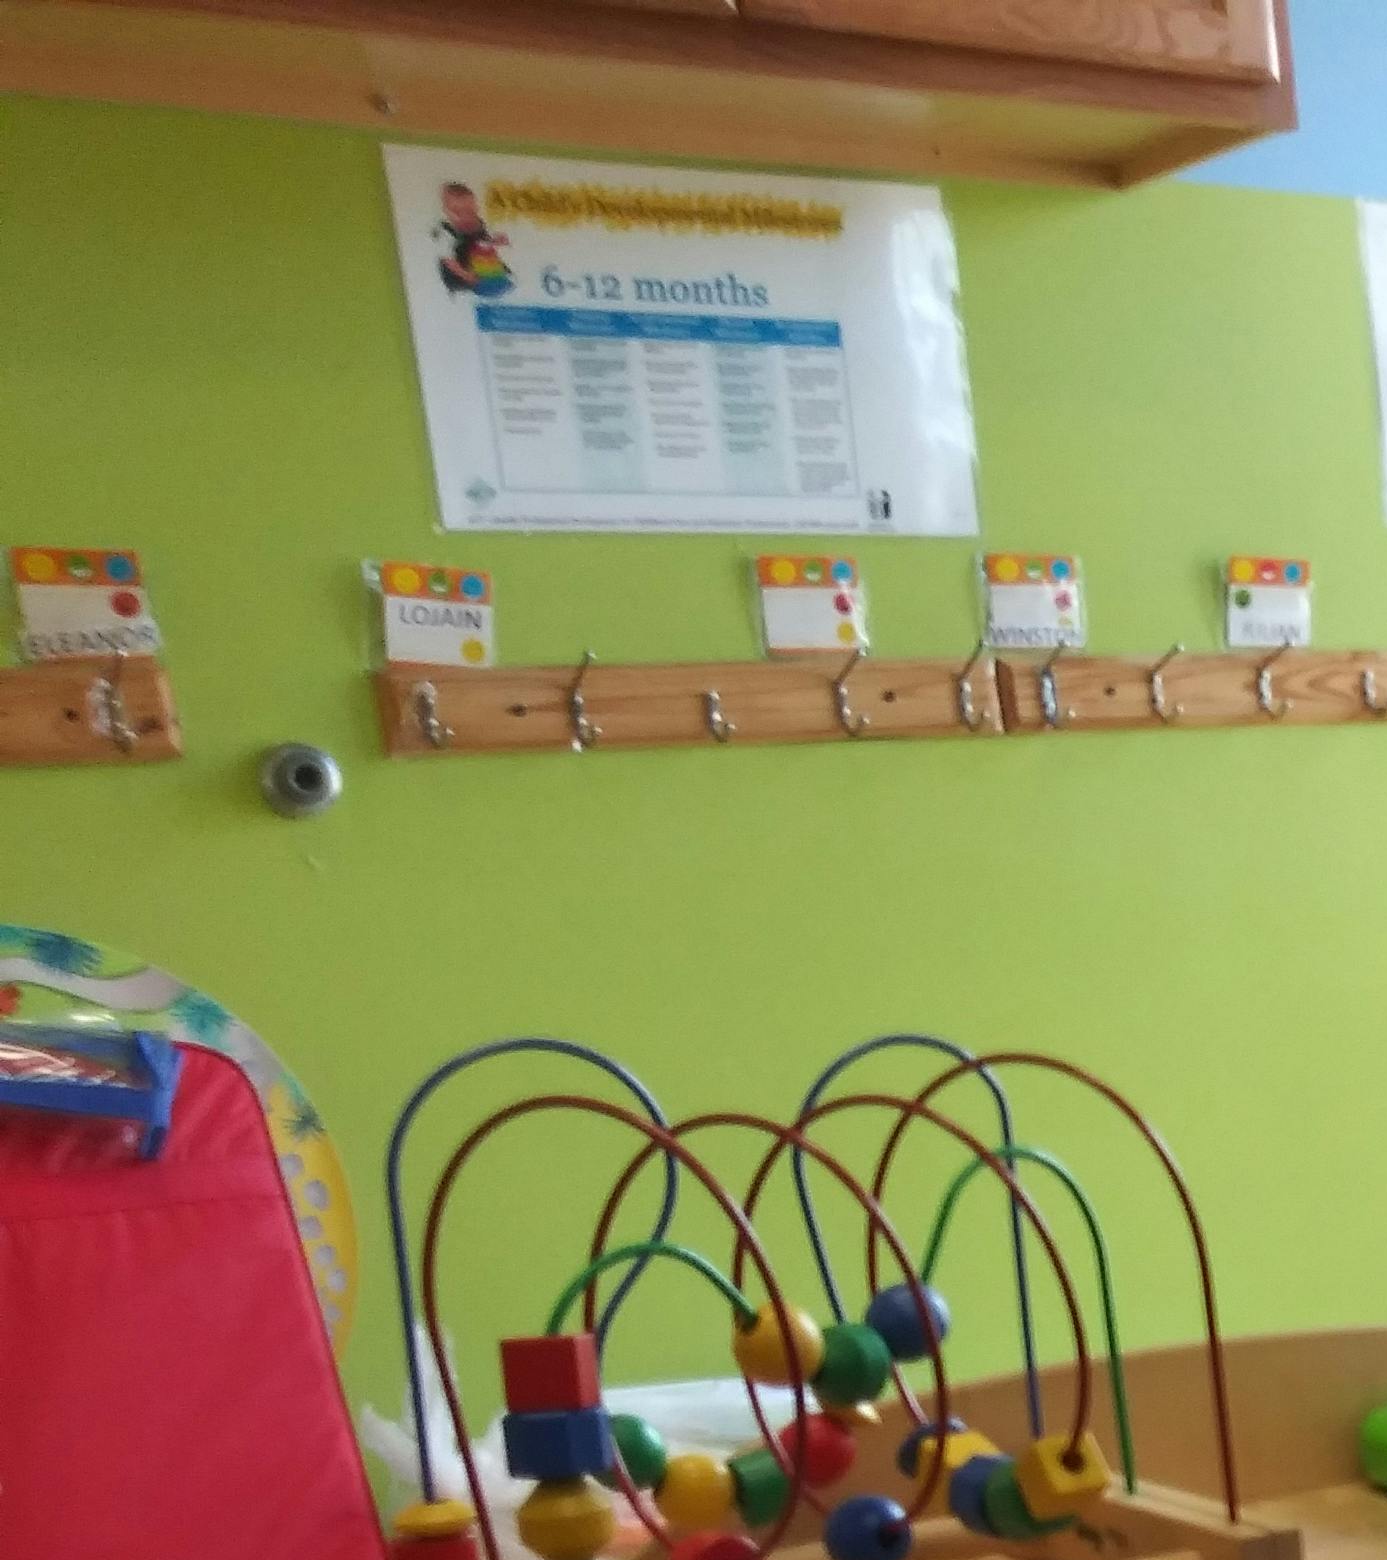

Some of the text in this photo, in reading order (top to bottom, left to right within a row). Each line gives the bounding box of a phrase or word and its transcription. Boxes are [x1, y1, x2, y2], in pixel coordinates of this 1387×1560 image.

[541, 263, 770, 307] 6-12 months
[399, 603, 483, 631] LOJAIN
[28, 625, 156, 657] ELEANOR
